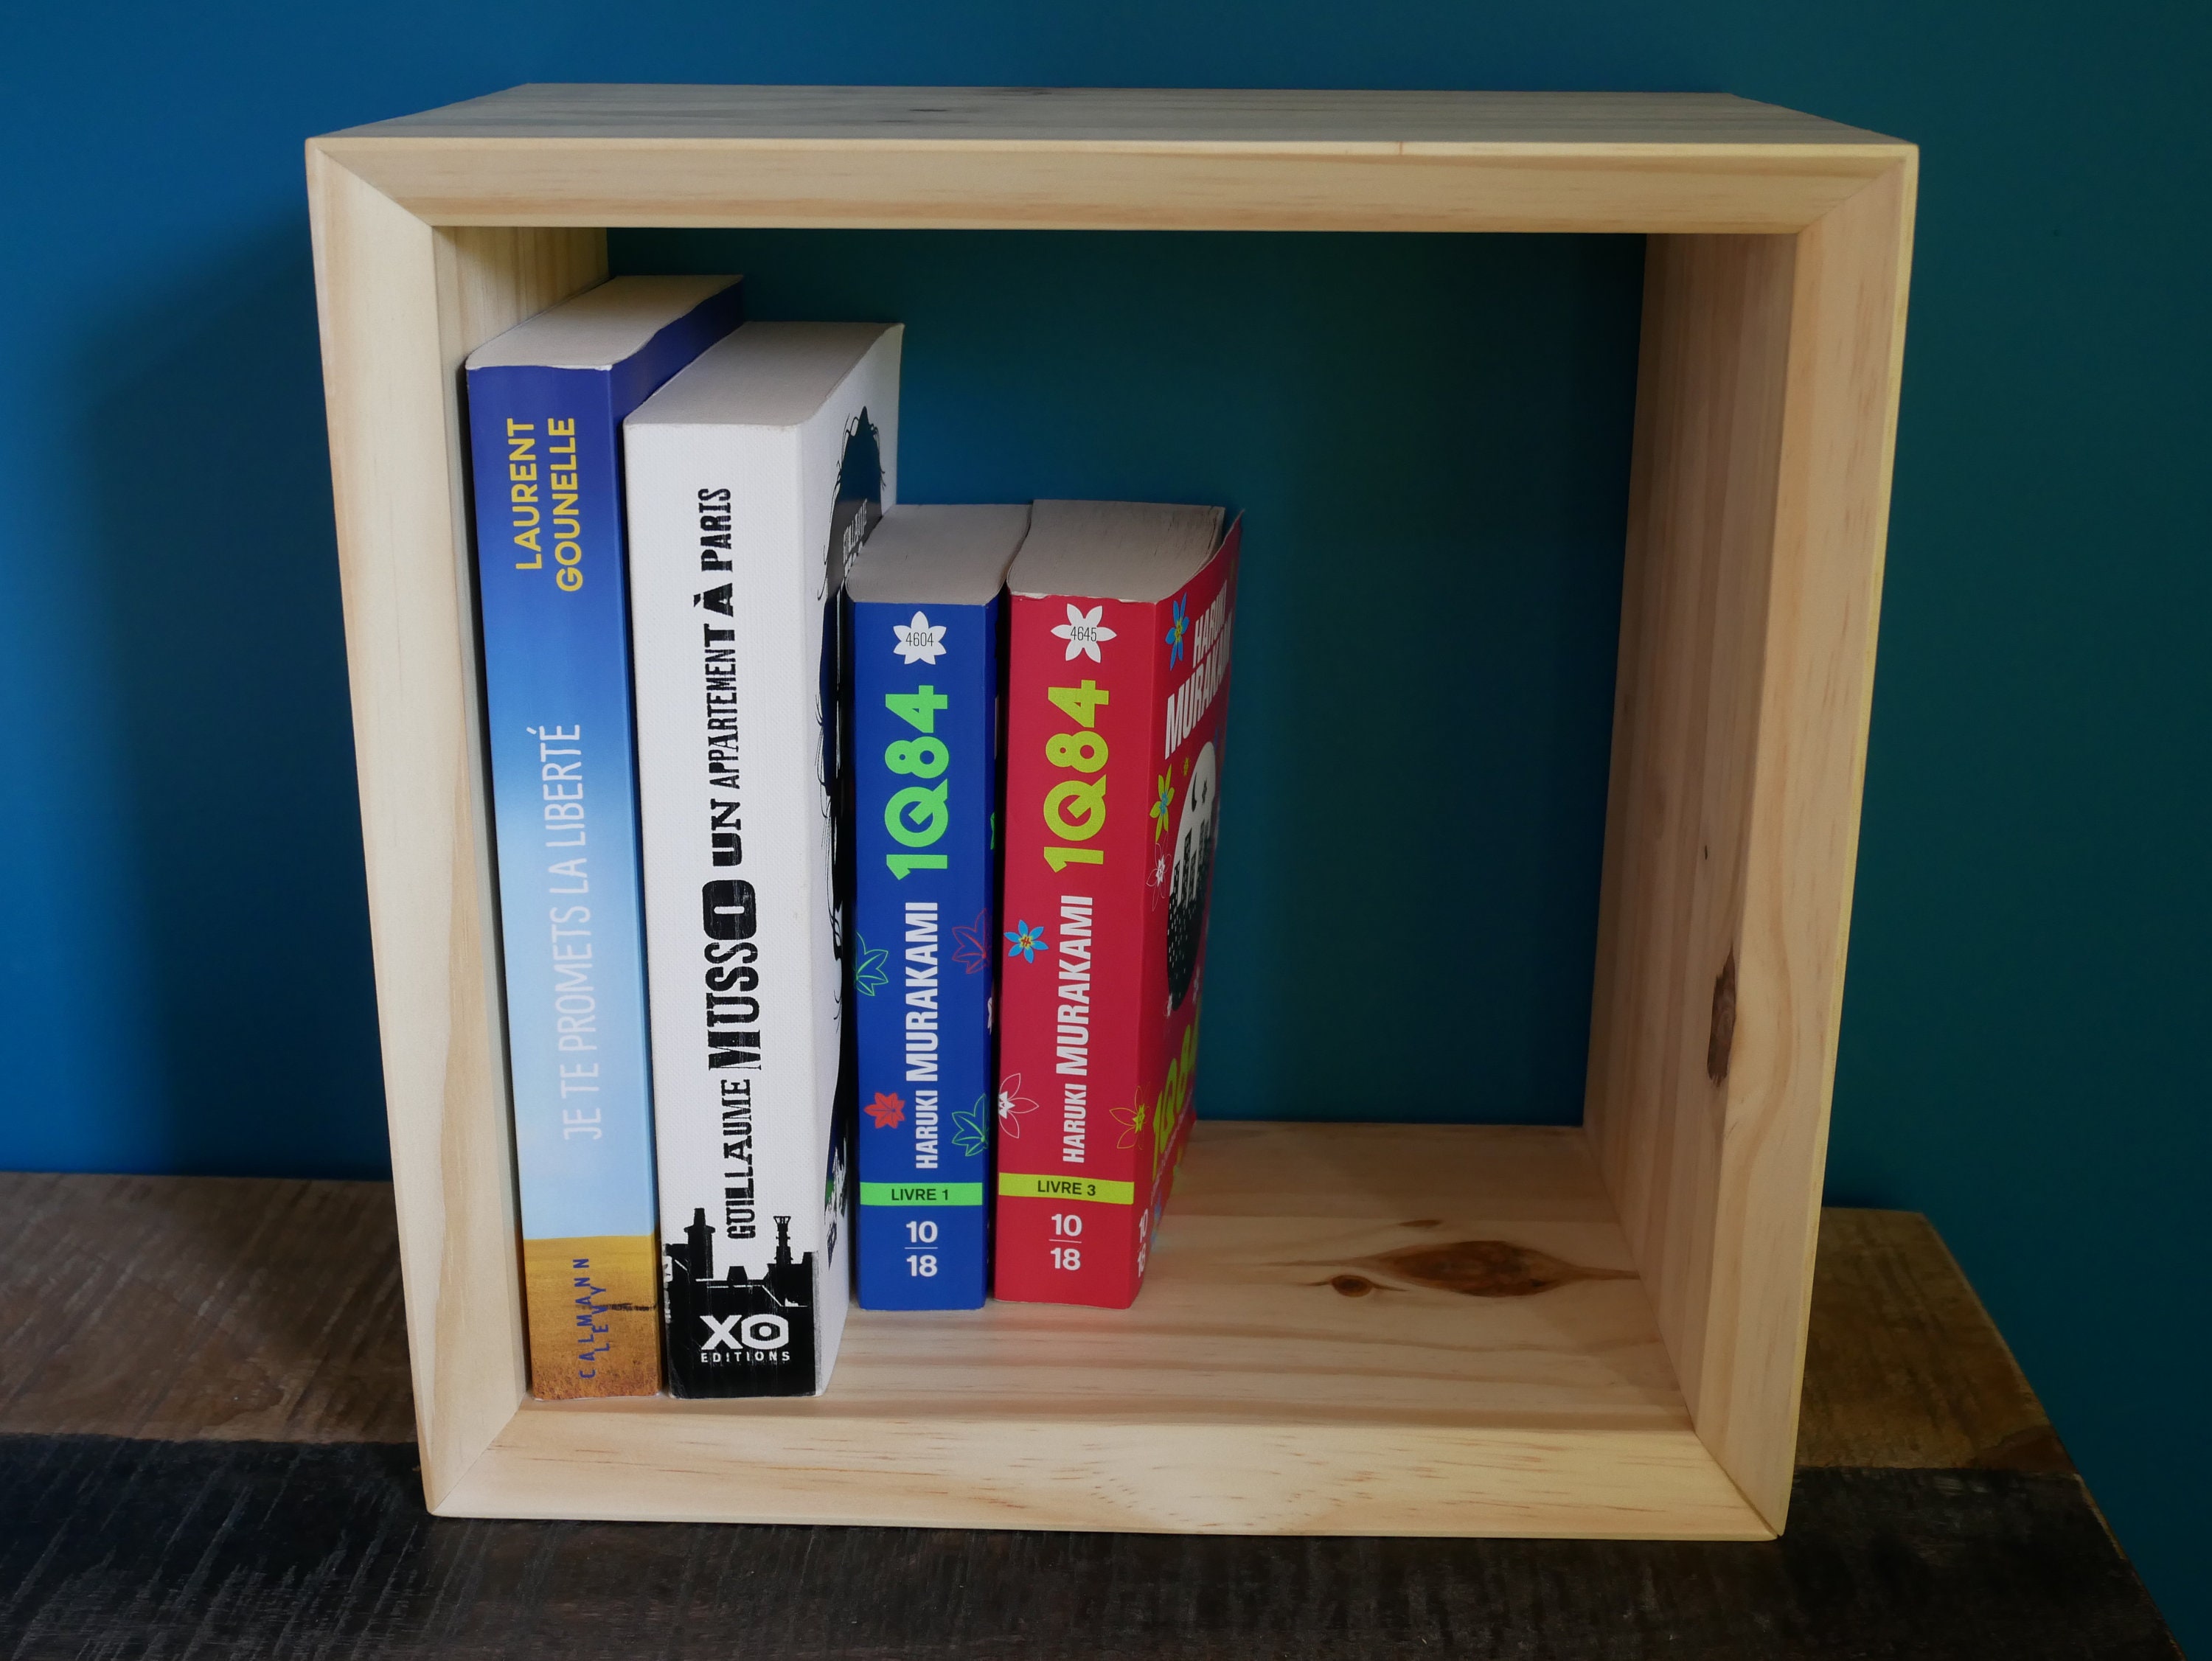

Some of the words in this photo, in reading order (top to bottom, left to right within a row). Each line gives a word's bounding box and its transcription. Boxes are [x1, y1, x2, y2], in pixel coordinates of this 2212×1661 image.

[507, 417, 542, 570] LAURENT
[547, 417, 583, 593] GOUNELLE
[698, 488, 733, 572] PARIS
[693, 582, 734, 617] À
[905, 633, 934, 647] 4604
[1070, 627, 1098, 642] 4645
[703, 624, 740, 789] APPARTEMENT
[526, 723, 587, 849] LIBERTÉ
[885, 685, 949, 880] 1Q84
[1043, 679, 1109, 873] 1Q84
[710, 798, 742, 867] UN
[548, 857, 589, 896] LA
[549, 905, 598, 1052] PROMETS
[701, 879, 762, 1070] MUSSO
[905, 902, 938, 1082] MURAKAMI
[1056, 895, 1093, 1076] MURAKAMI
[560, 1062, 599, 1100] TE
[563, 1107, 602, 1141] JE
[915, 1090, 938, 1169] HARUKI
[1062, 1083, 1087, 1163] HARUKI
[720, 1079, 757, 1240] GUILLAUME
[1037, 1180, 1082, 1194] LIVRE
[1087, 1185, 1096, 1197] 3
[891, 1188, 936, 1201] LIVRE
[942, 1189, 948, 1200] 1
[1051, 1213, 1082, 1236] 10
[1138, 1208, 1149, 1243] 10
[905, 1221, 939, 1243] 10
[906, 1255, 938, 1277] 18
[1050, 1247, 1081, 1270] 18
[572, 1258, 596, 1379] CALMANN
[700, 1314, 789, 1350] XO
[700, 1351, 790, 1363] EDITIONS
